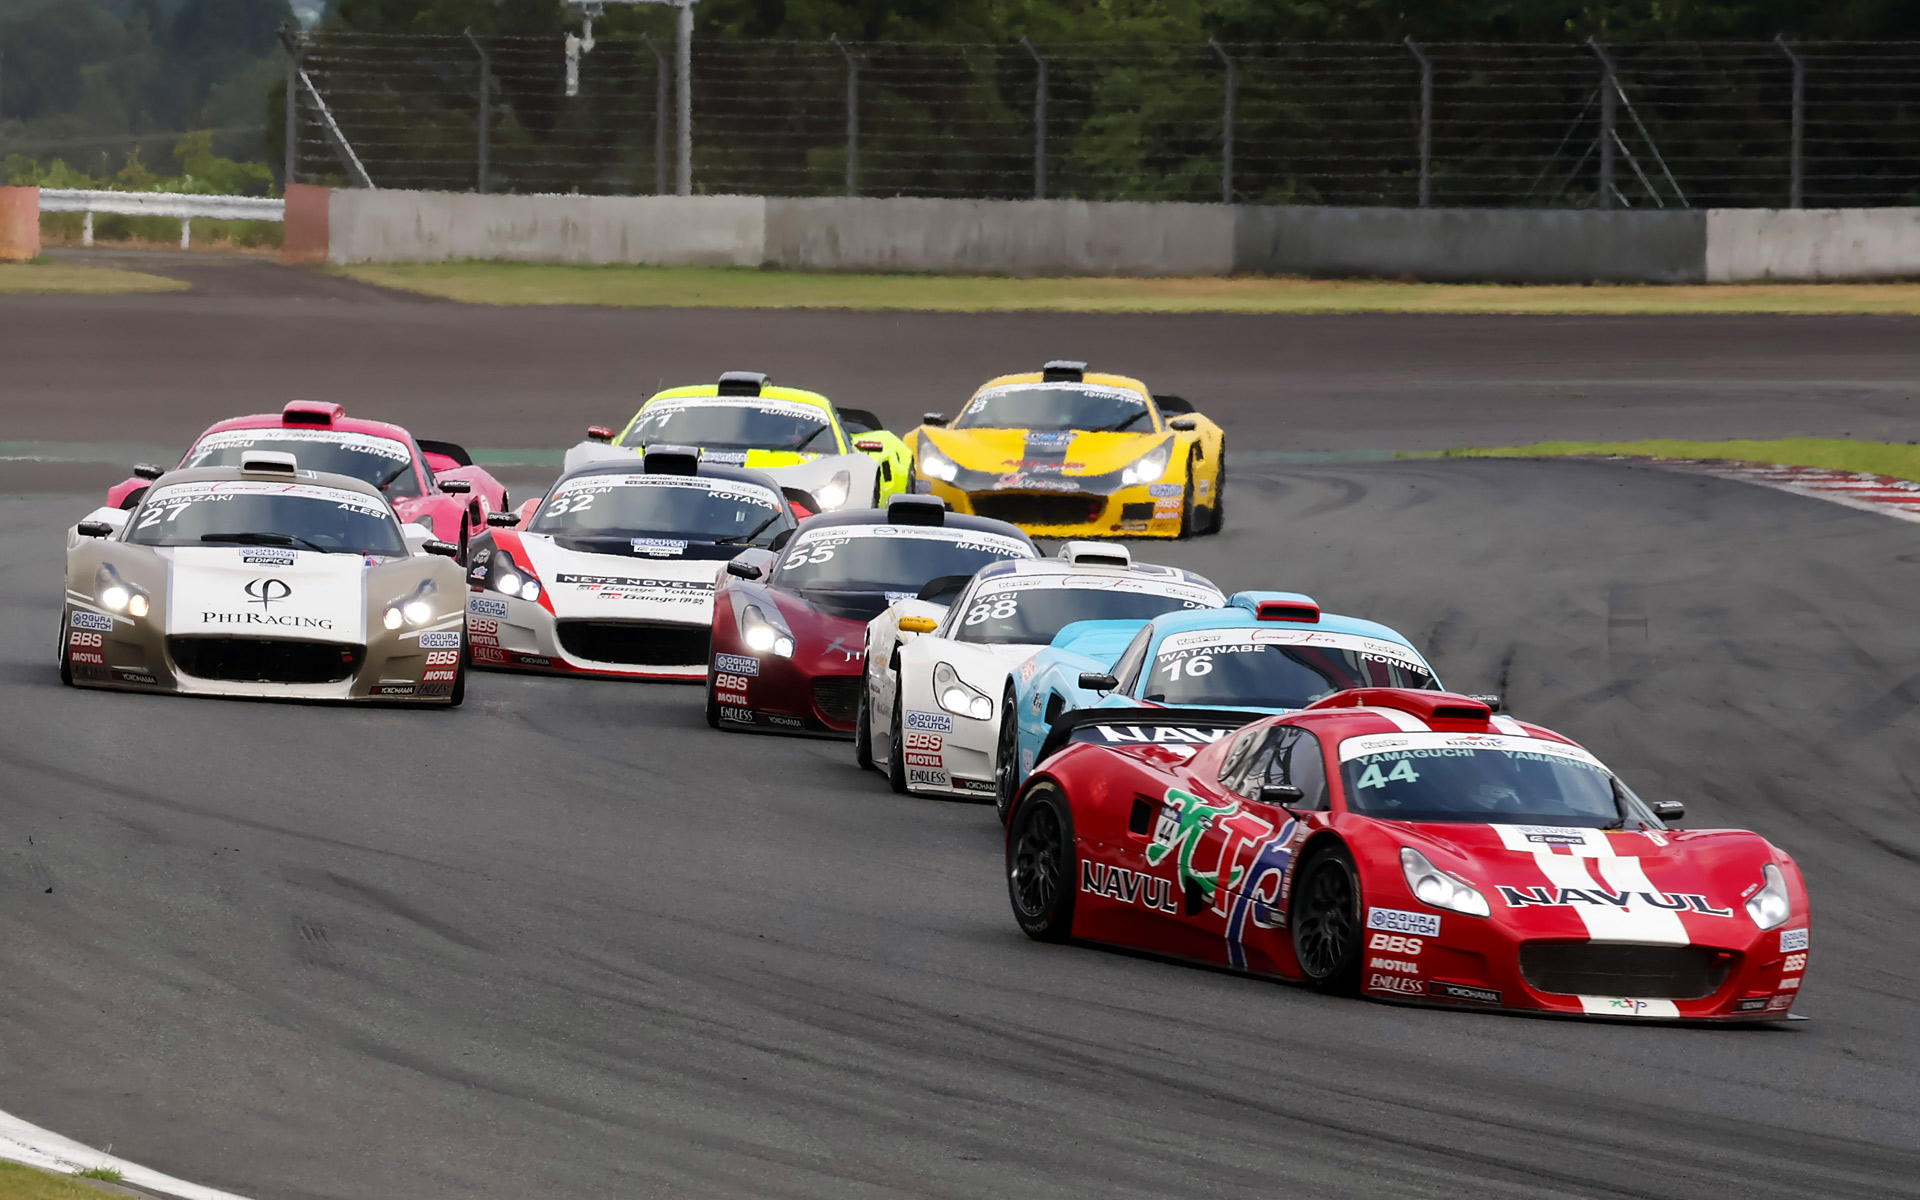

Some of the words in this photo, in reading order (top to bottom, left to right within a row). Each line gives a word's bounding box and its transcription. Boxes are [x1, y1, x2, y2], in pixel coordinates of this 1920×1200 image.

[562, 486, 613, 498] NAGAI
[146, 494, 235, 509] YAMAZAKI
[545, 495, 595, 517] 32
[708, 490, 773, 510] KOTAKA
[137, 502, 192, 530] 27
[337, 503, 387, 519] ALESI
[810, 538, 850, 547] YAGI
[955, 541, 1022, 558] MAKINO
[245, 557, 292, 565] EDIFICE
[782, 545, 836, 570] 55
[626, 579, 697, 588] NOVEL
[478, 600, 506, 609] OGURA
[976, 592, 1017, 604] YAGI
[82, 614, 112, 623] OGURA
[478, 606, 506, 616] CLUTCH
[965, 600, 1018, 626] 88
[81, 621, 111, 630] CLUTCH
[469, 618, 498, 633] BBS
[70, 632, 103, 648] BBS
[471, 635, 498, 646] MOTUL
[72, 652, 103, 664] MOTUL
[425, 651, 458, 665] BBS
[474, 646, 503, 660] ENDLESS
[1158, 645, 1266, 662] WATANABE
[726, 664, 757, 674] CLUTCH
[727, 657, 757, 667] OGURA
[1161, 655, 1213, 681] 16
[1360, 652, 1429, 676] RONNIE
[423, 671, 454, 680] MOTUL
[715, 674, 748, 691] BBS
[717, 693, 748, 705] MOTUL
[720, 706, 753, 721] ENDLESS
[917, 714, 951, 724] OGURA
[917, 721, 951, 731] CLUTCH
[905, 732, 942, 751] BBS
[907, 754, 941, 766] MOTUL
[1356, 748, 1476, 766] YAMAGUCHI
[910, 770, 946, 783] ENDLESS
[1356, 759, 1420, 789] 44
[1081, 859, 1178, 914] NAVUL
[1494, 884, 1734, 918] NAVUL
[1387, 912, 1437, 926] OGURA
[1387, 920, 1437, 934] CLUTCH
[1368, 933, 1423, 955] BBS
[1370, 957, 1419, 974] MOTUL
[1782, 953, 1807, 972] BBS
[1370, 973, 1424, 993] ENDLESS
[1446, 986, 1498, 1001] YOKOHAMA
